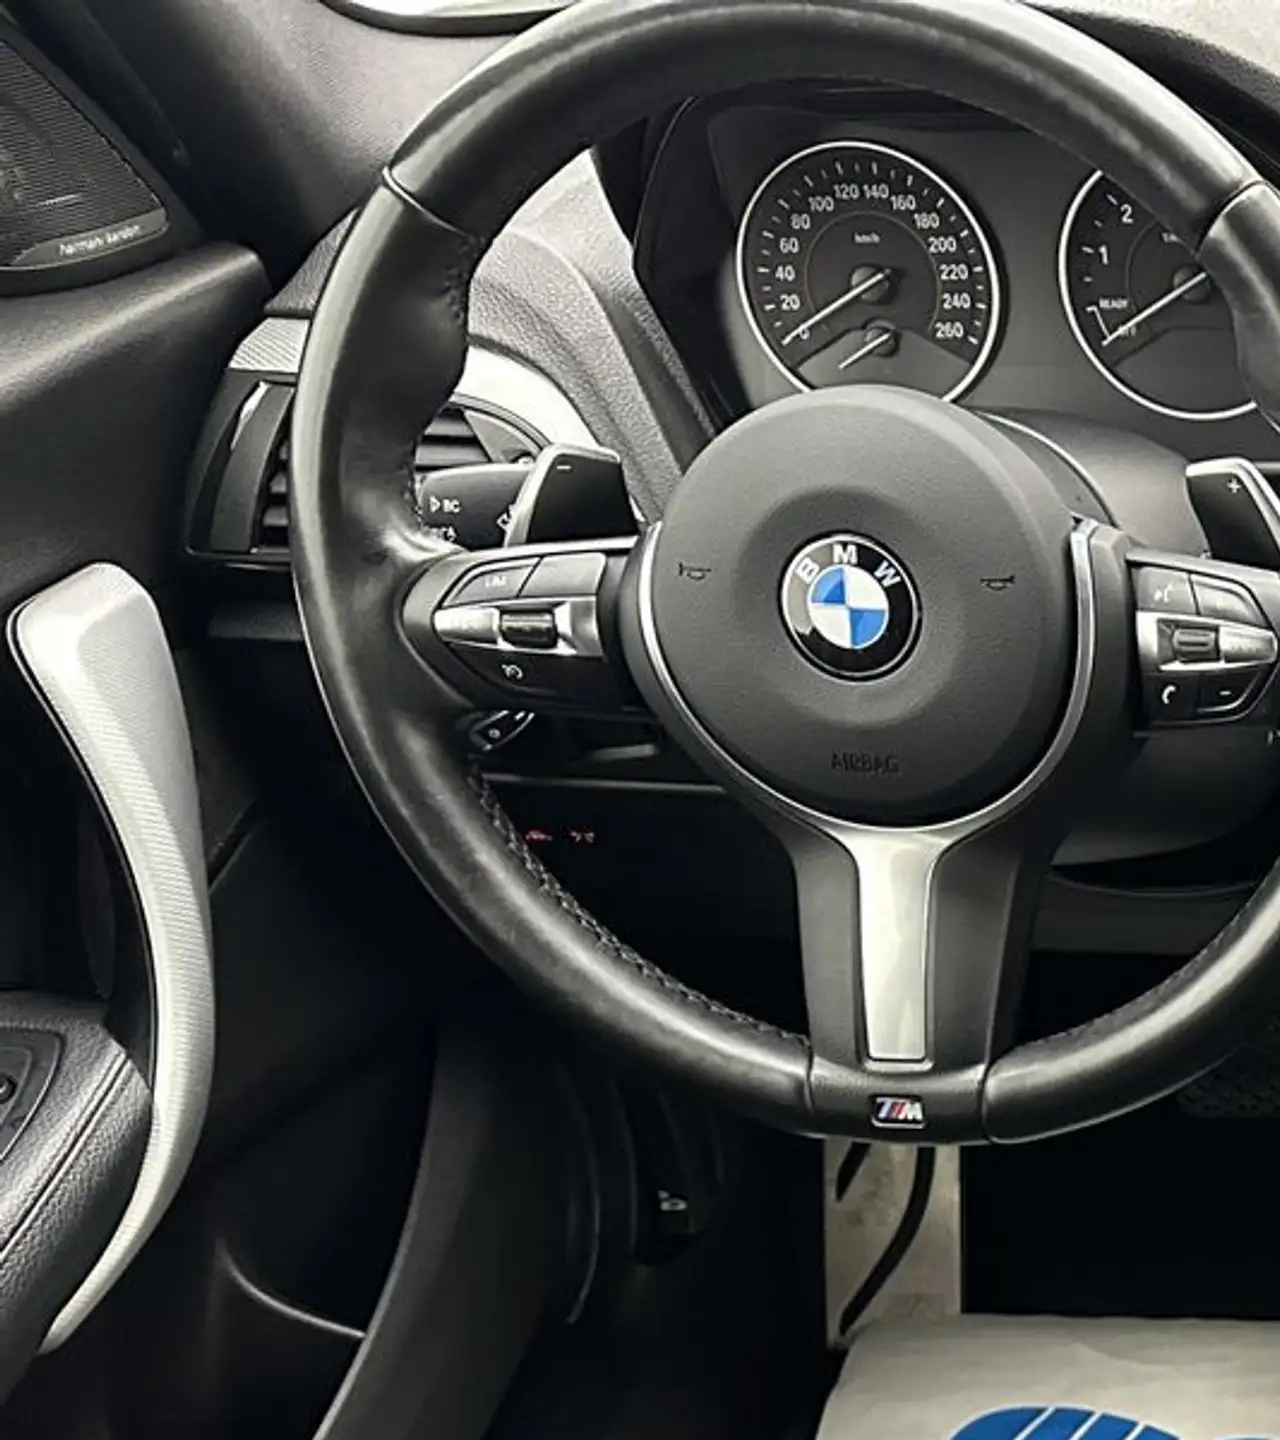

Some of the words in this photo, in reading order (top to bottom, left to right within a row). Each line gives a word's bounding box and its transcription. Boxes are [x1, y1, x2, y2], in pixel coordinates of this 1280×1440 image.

[834, 184, 859, 199] 120
[863, 184, 889, 199] 140
[808, 196, 834, 212] 100
[891, 195, 916, 210] 160
[790, 213, 810, 229] 80
[914, 213, 939, 229] 180
[1120, 203, 1134, 224] 2
[779, 237, 799, 254] 60
[928, 237, 956, 253] 200
[1098, 244, 1109, 265] 1
[775, 265, 795, 281] 40
[940, 264, 968, 280] 220
[780, 294, 800, 310] 20
[943, 294, 970, 309] 240
[935, 322, 963, 338] 260
[795, 543, 901, 588] BMW
